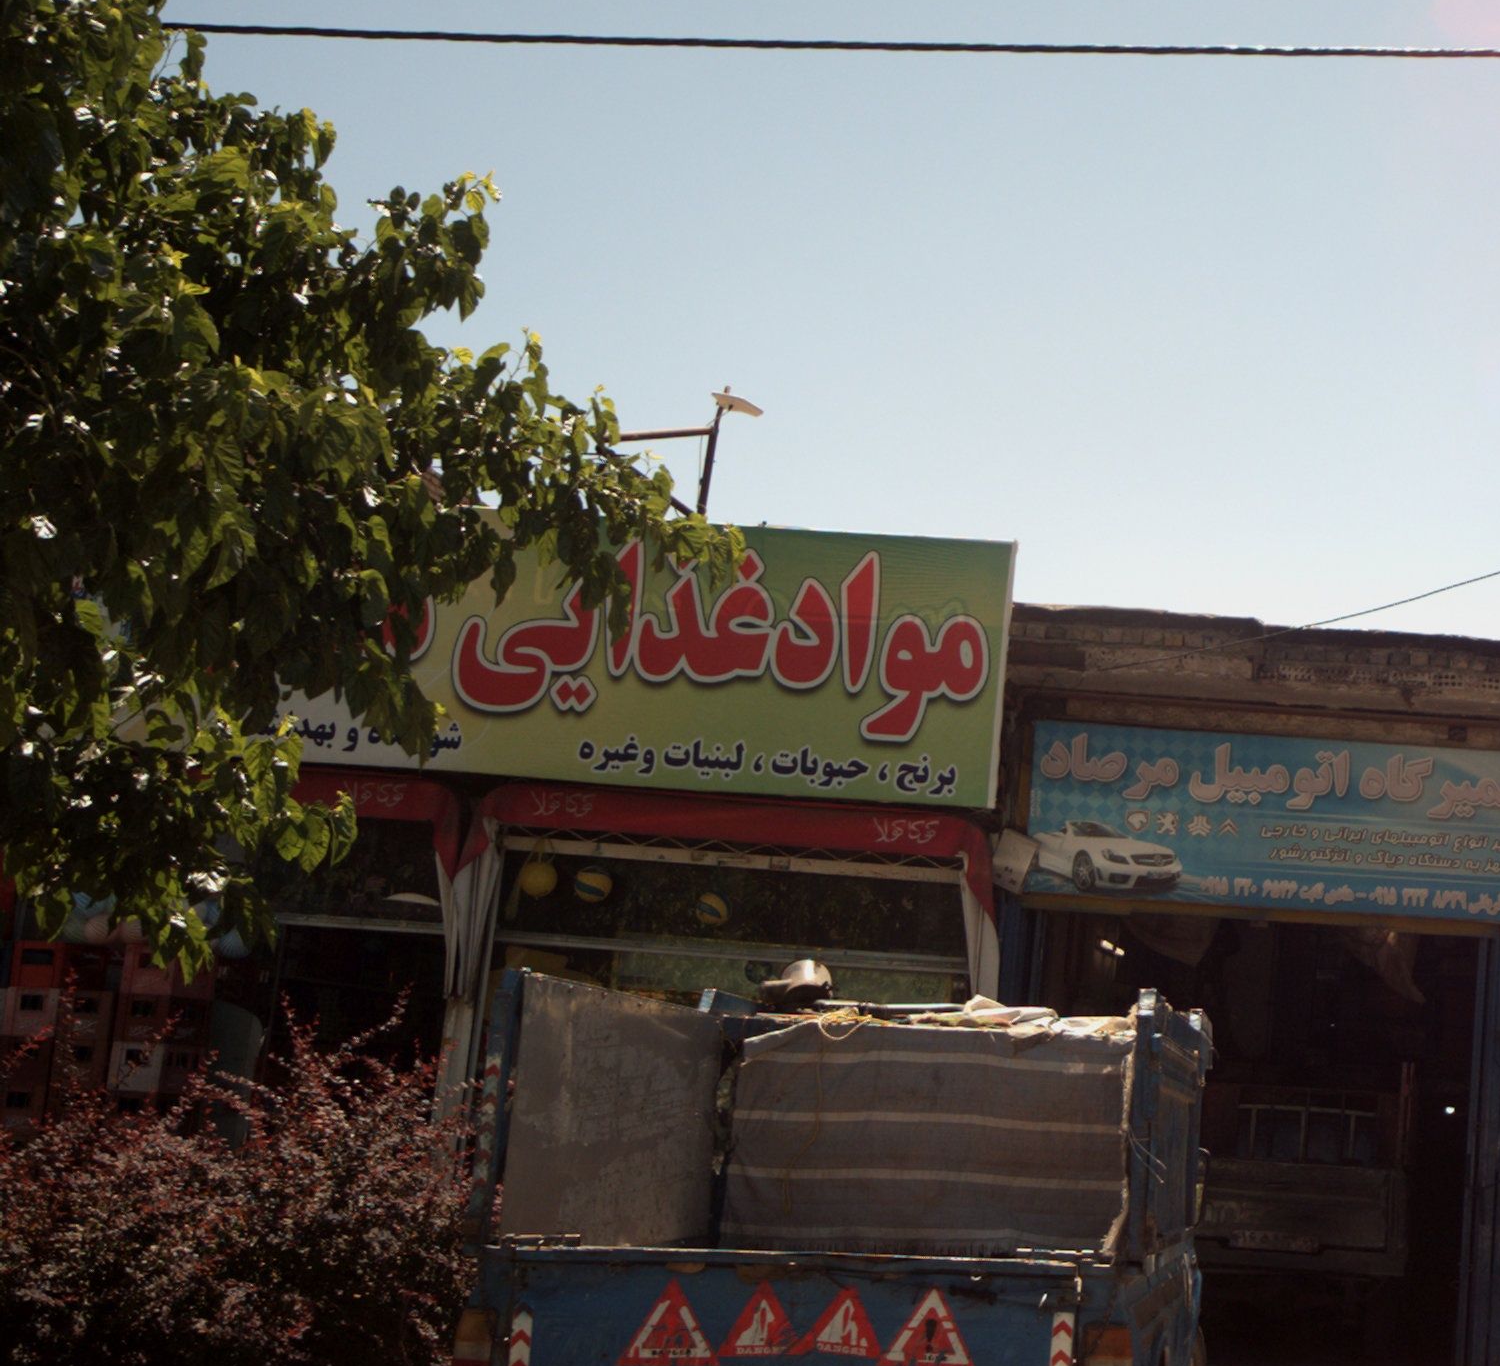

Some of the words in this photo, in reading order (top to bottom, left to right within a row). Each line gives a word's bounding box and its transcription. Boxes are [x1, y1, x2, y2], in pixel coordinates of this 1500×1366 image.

[663, 741, 746, 782] لبنیات
[1188, 741, 1351, 810] اتومبیل
[1311, 828, 1320, 841] و
[1453, 834, 1489, 852] انواع
